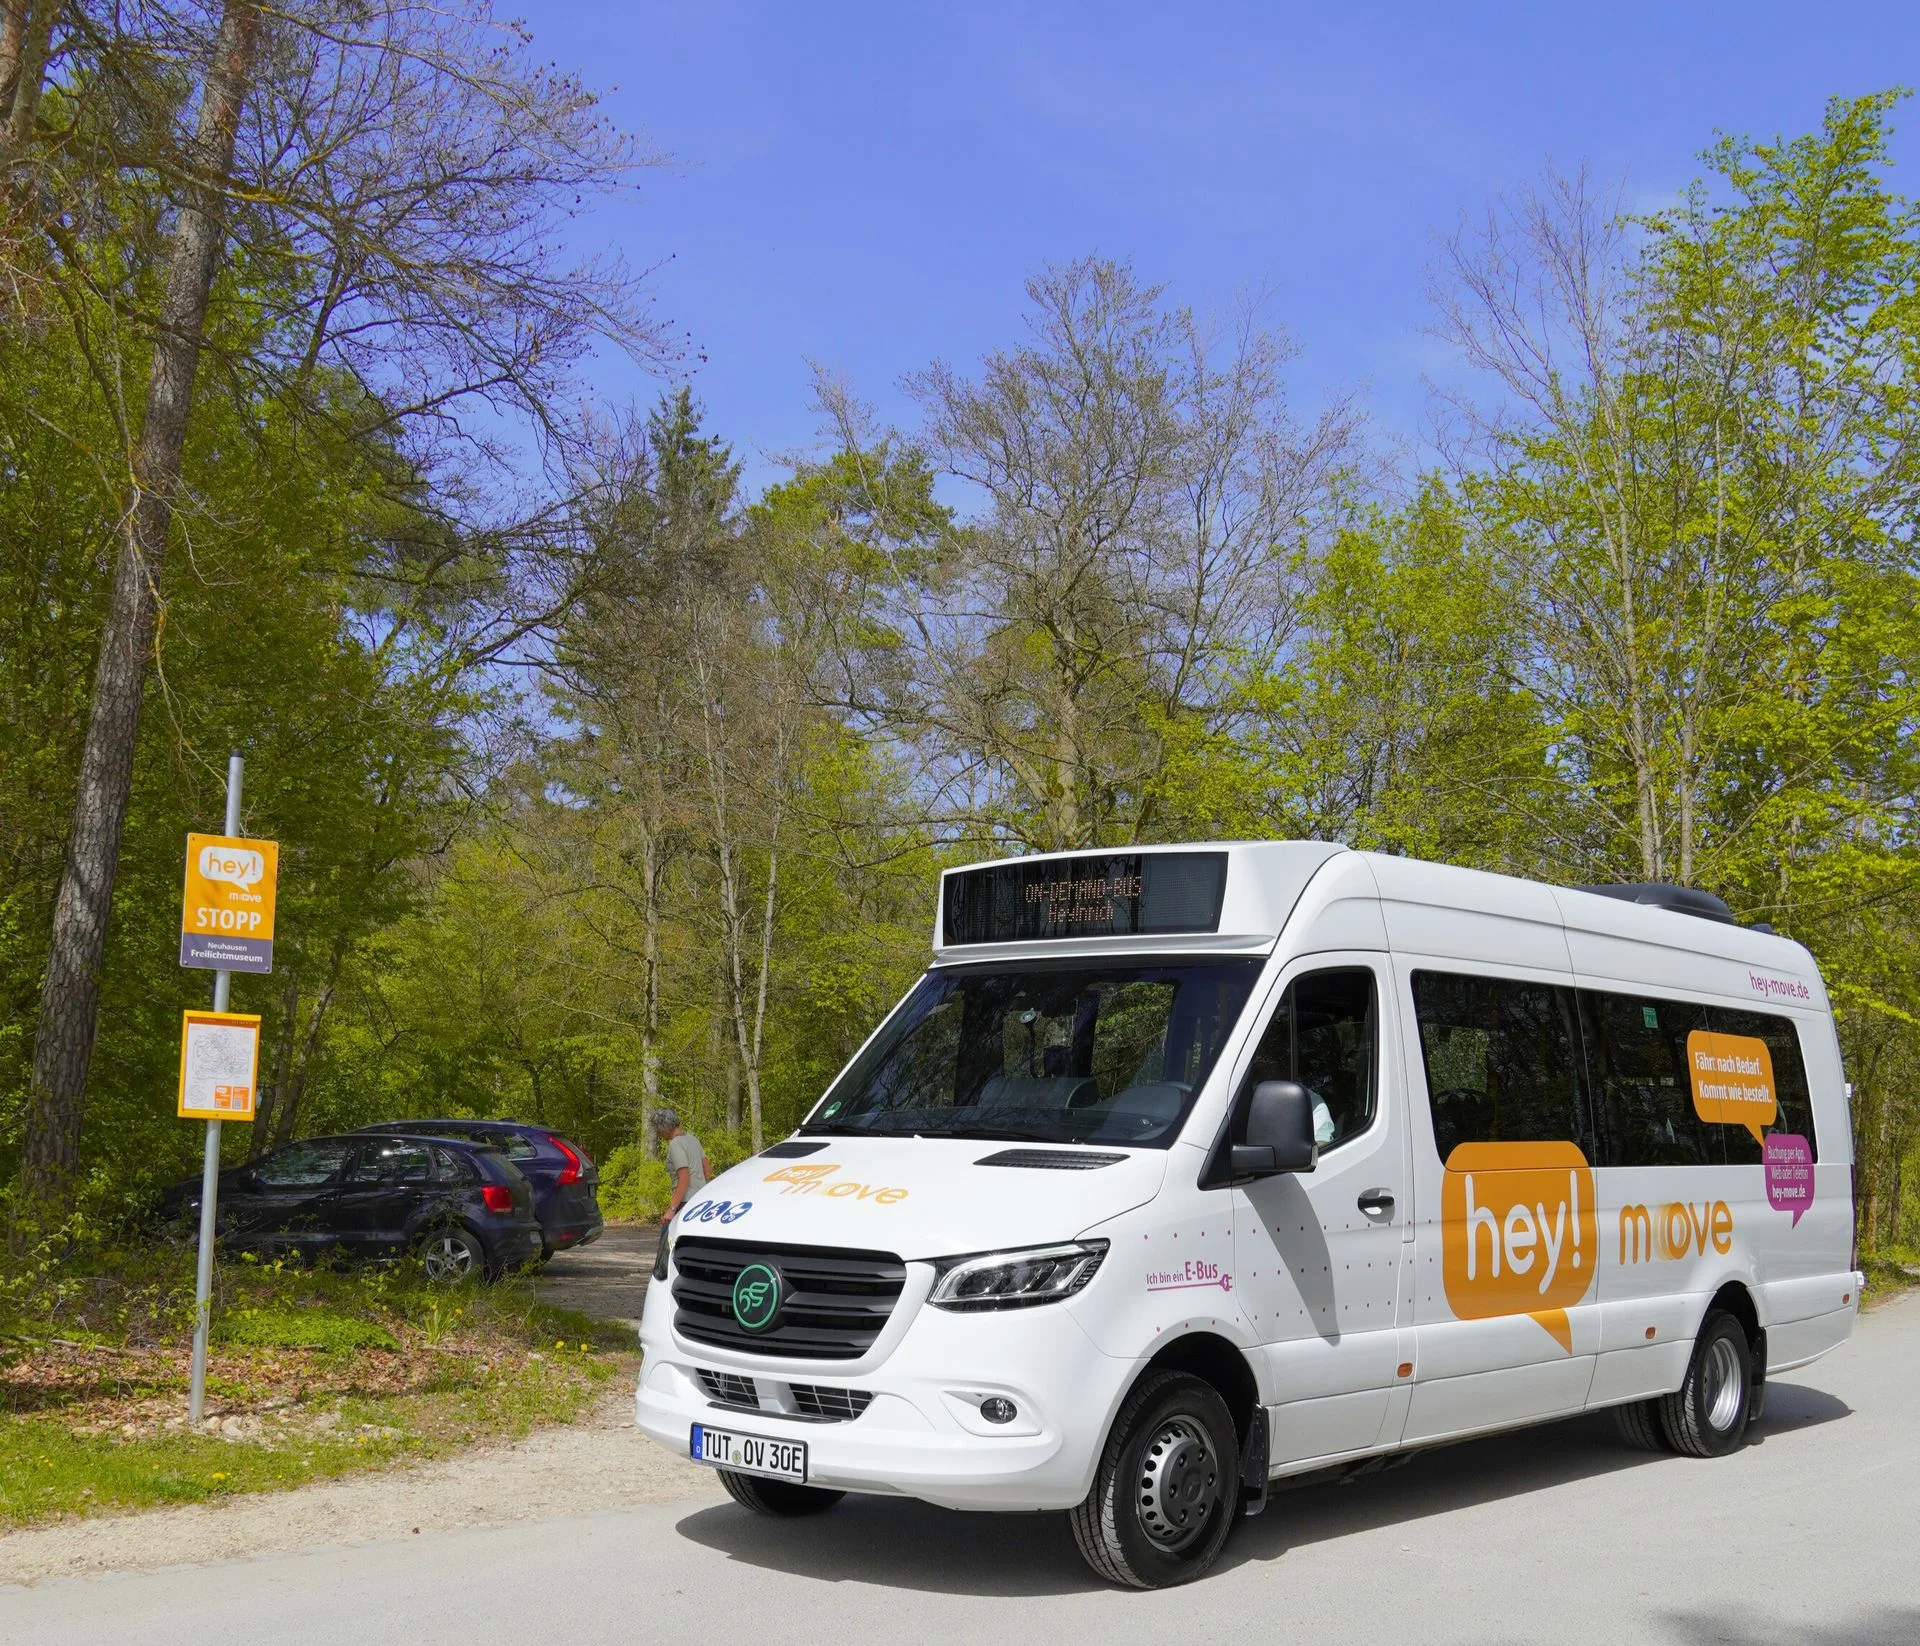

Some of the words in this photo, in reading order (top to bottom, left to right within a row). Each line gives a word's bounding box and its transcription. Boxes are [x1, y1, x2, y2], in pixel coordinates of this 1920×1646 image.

[208, 852, 256, 879] hey!
[1025, 876, 1142, 903] ON-DEMAND-BUS
[196, 907, 262, 931] STOPP
[191, 949, 263, 963] Freilichtmuseum
[207, 942, 248, 952] Neuhausen
[1749, 970, 1810, 999] hey-move.de
[1695, 1051, 1716, 1071] Fährt
[1717, 1054, 1735, 1073] nach
[1735, 1056, 1763, 1076] Bedarf.
[1698, 1079, 1728, 1100] Kommt
[1728, 1083, 1743, 1101] wie
[1742, 1082, 1773, 1103] bestellt.
[1767, 1145, 1787, 1163] Buchung
[1787, 1149, 1795, 1163] per
[1782, 1165, 1792, 1180] oder
[1792, 1165, 1809, 1180] Telefon
[1772, 1184, 1806, 1202] hey-move.de
[1465, 1170, 1580, 1294] hey!
[1146, 1272, 1158, 1285] Ich
[1160, 1271, 1172, 1284] bin
[1172, 1270, 1184, 1283] ein
[1184, 1260, 1218, 1281] E-Bus
[703, 1432, 731, 1460] TUT
[744, 1439, 765, 1467] OV
[769, 1443, 802, 1473] 30E
